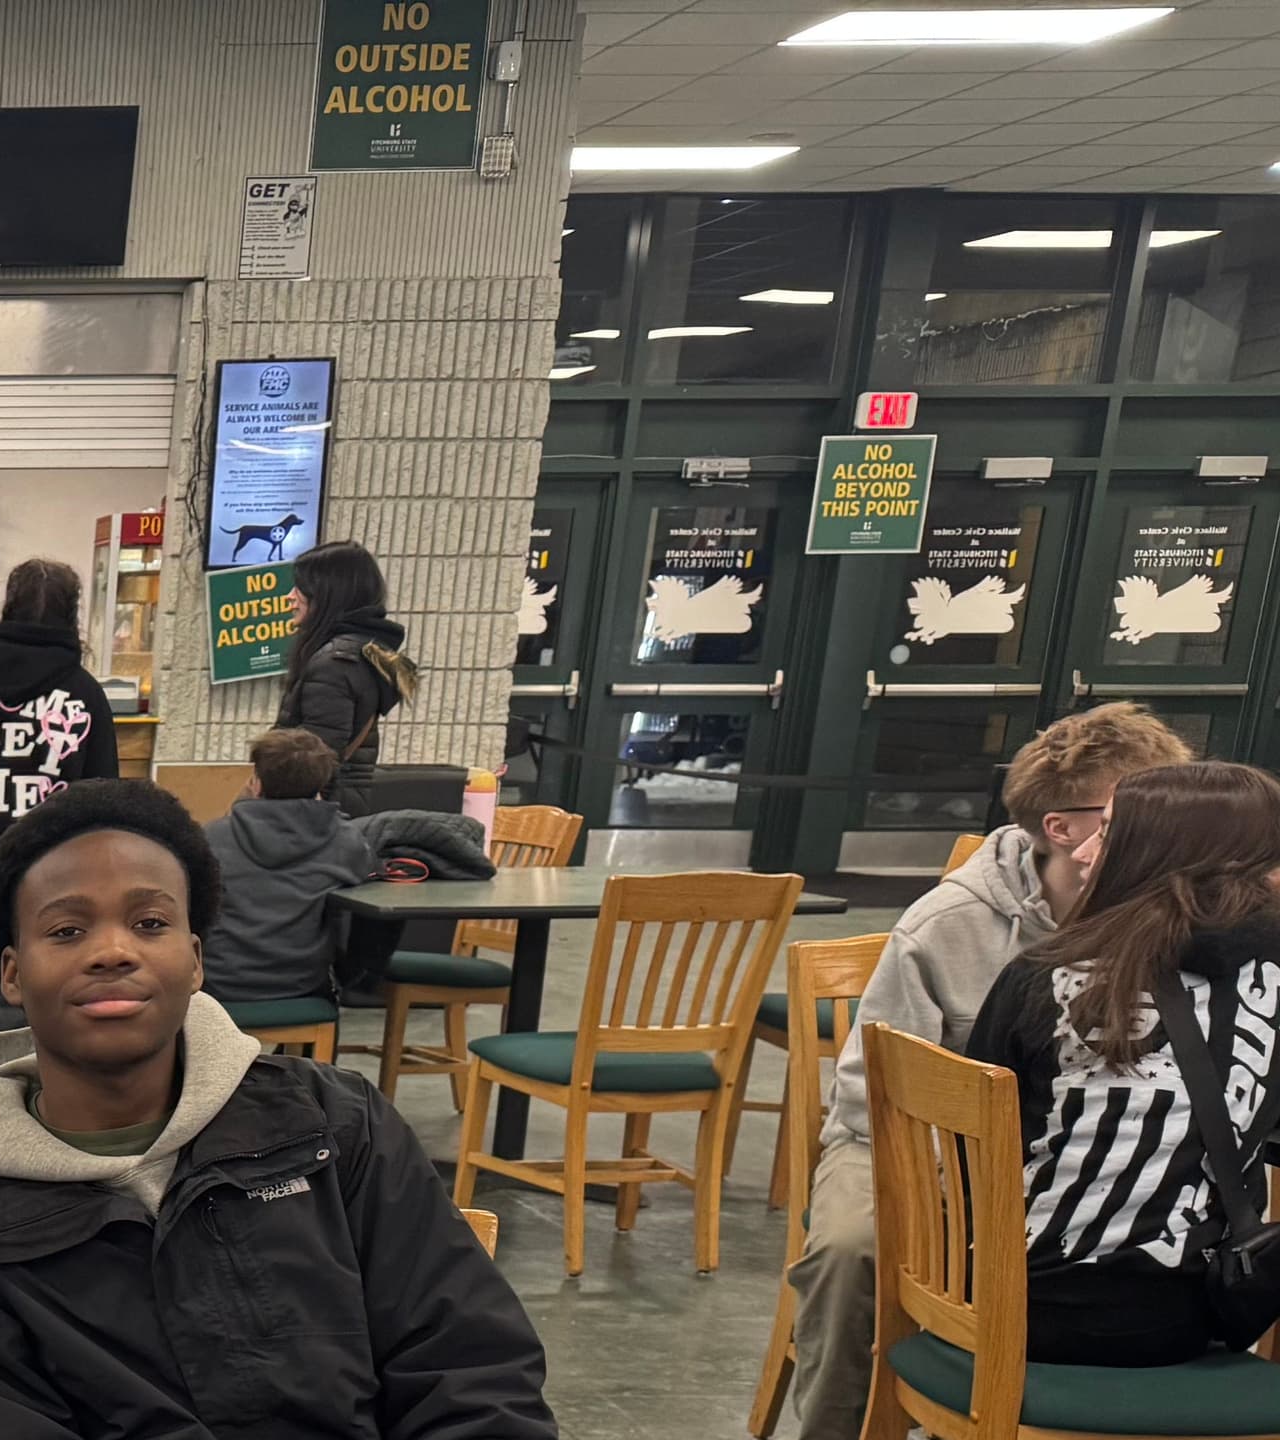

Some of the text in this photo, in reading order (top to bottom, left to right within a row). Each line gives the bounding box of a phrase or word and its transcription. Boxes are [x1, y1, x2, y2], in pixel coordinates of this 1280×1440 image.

[382, 2, 430, 31] NO
[335, 43, 471, 72] OUTSIDE
[323, 84, 472, 114] ALCOHOL
[249, 183, 290, 198] GET
[225, 402, 319, 412] SERVICE ANIMALS ARE
[866, 394, 911, 426] EXIT
[226, 413, 317, 423] ALWAYS WELCOME IN
[243, 426, 261, 434] OUR
[864, 444, 893, 461] NO
[832, 463, 918, 479] ALCOHOL
[834, 482, 911, 498] BEYOND
[821, 500, 919, 517] THIS POINT
[246, 572, 277, 593] NO
[219, 595, 293, 622] OUTSID
[216, 618, 299, 648] ALCOHO
[263, 1185, 293, 1202] FACE
